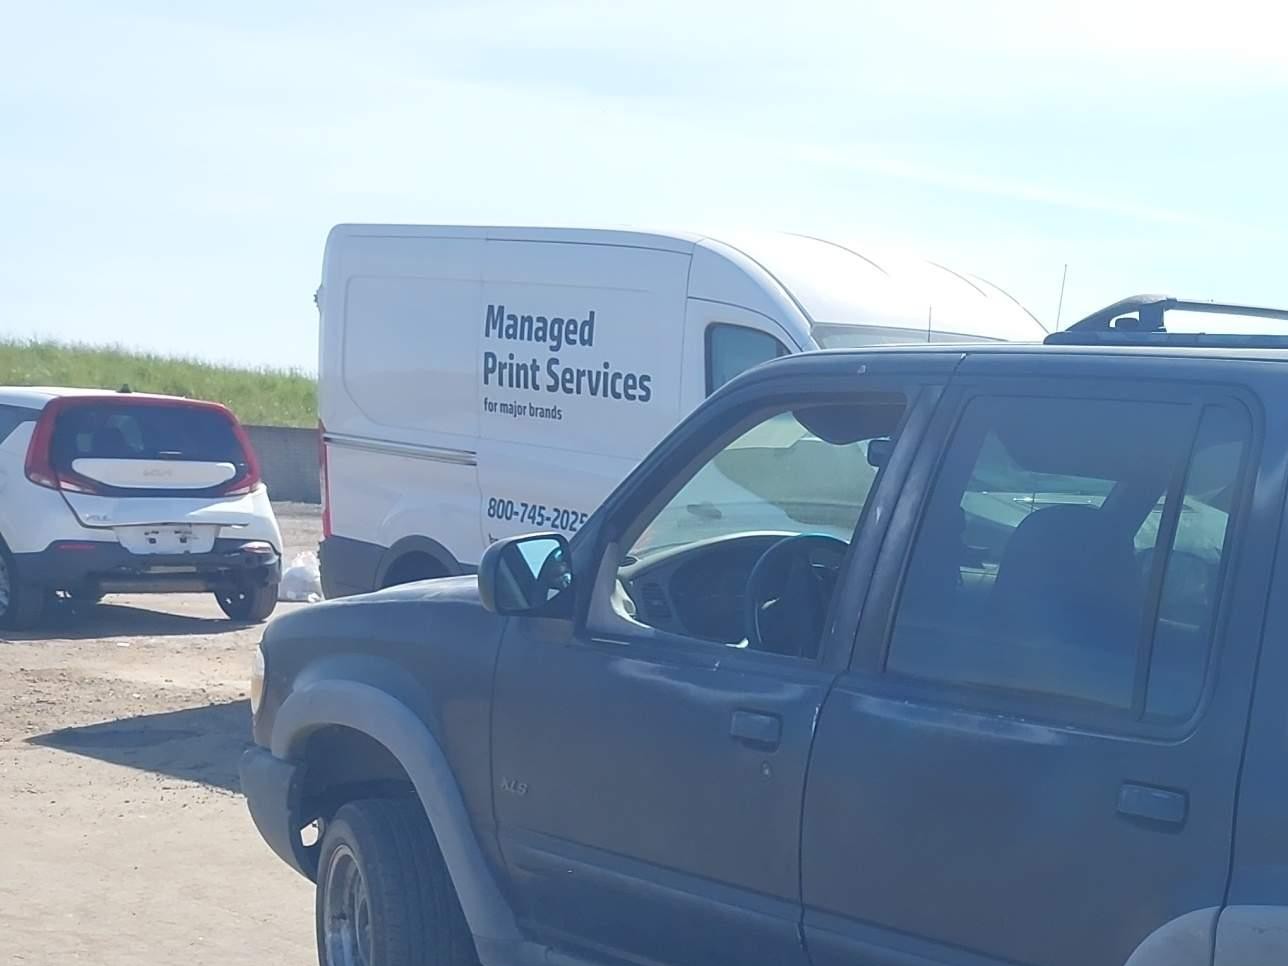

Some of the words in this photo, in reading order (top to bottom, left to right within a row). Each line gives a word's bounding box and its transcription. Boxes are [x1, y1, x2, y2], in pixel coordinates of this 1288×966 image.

[485, 304, 595, 352] Managed
[483, 351, 540, 391] Print
[546, 357, 652, 402] Services
[484, 397, 498, 412] for
[499, 401, 527, 418] major
[528, 402, 562, 420] brands
